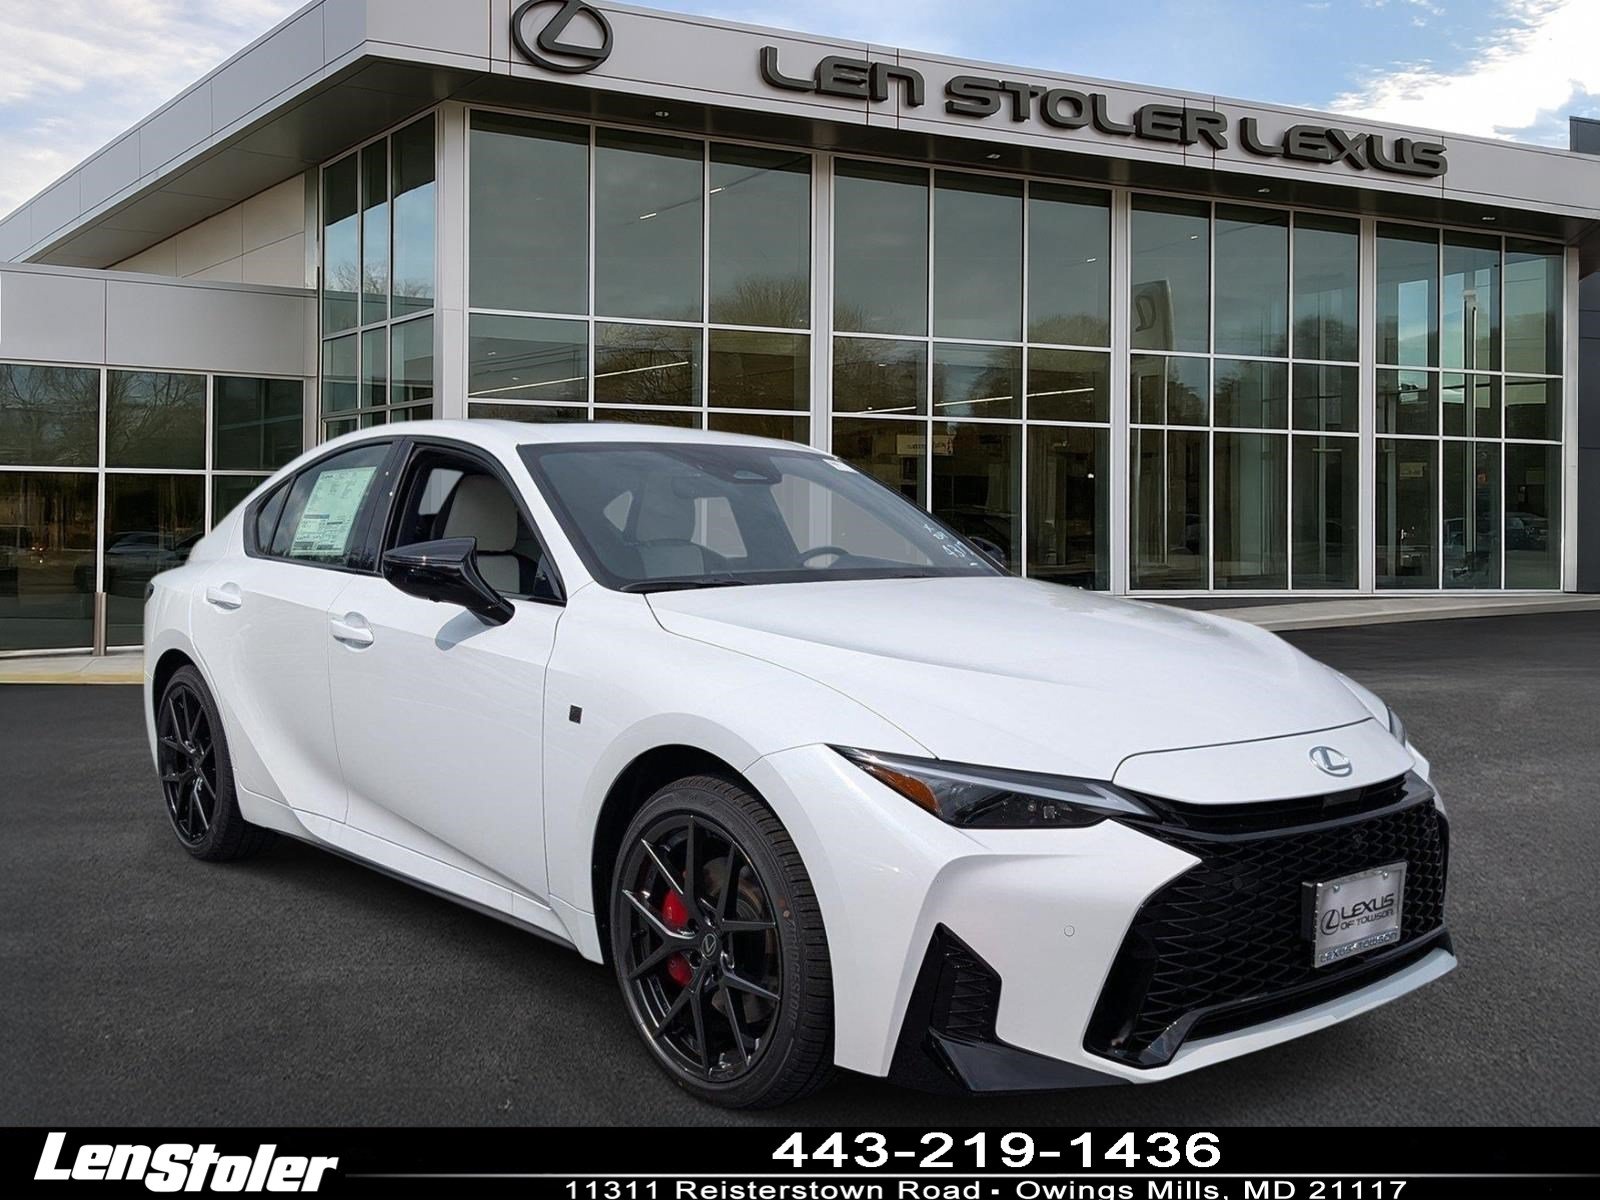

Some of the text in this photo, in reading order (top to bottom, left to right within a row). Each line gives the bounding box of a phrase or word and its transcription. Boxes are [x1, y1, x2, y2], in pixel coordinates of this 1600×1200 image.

[760, 46, 1448, 178] LEN STOLER LEXUS
[1341, 892, 1395, 920] LEXUS
[1341, 908, 1394, 930] OF TOWSON
